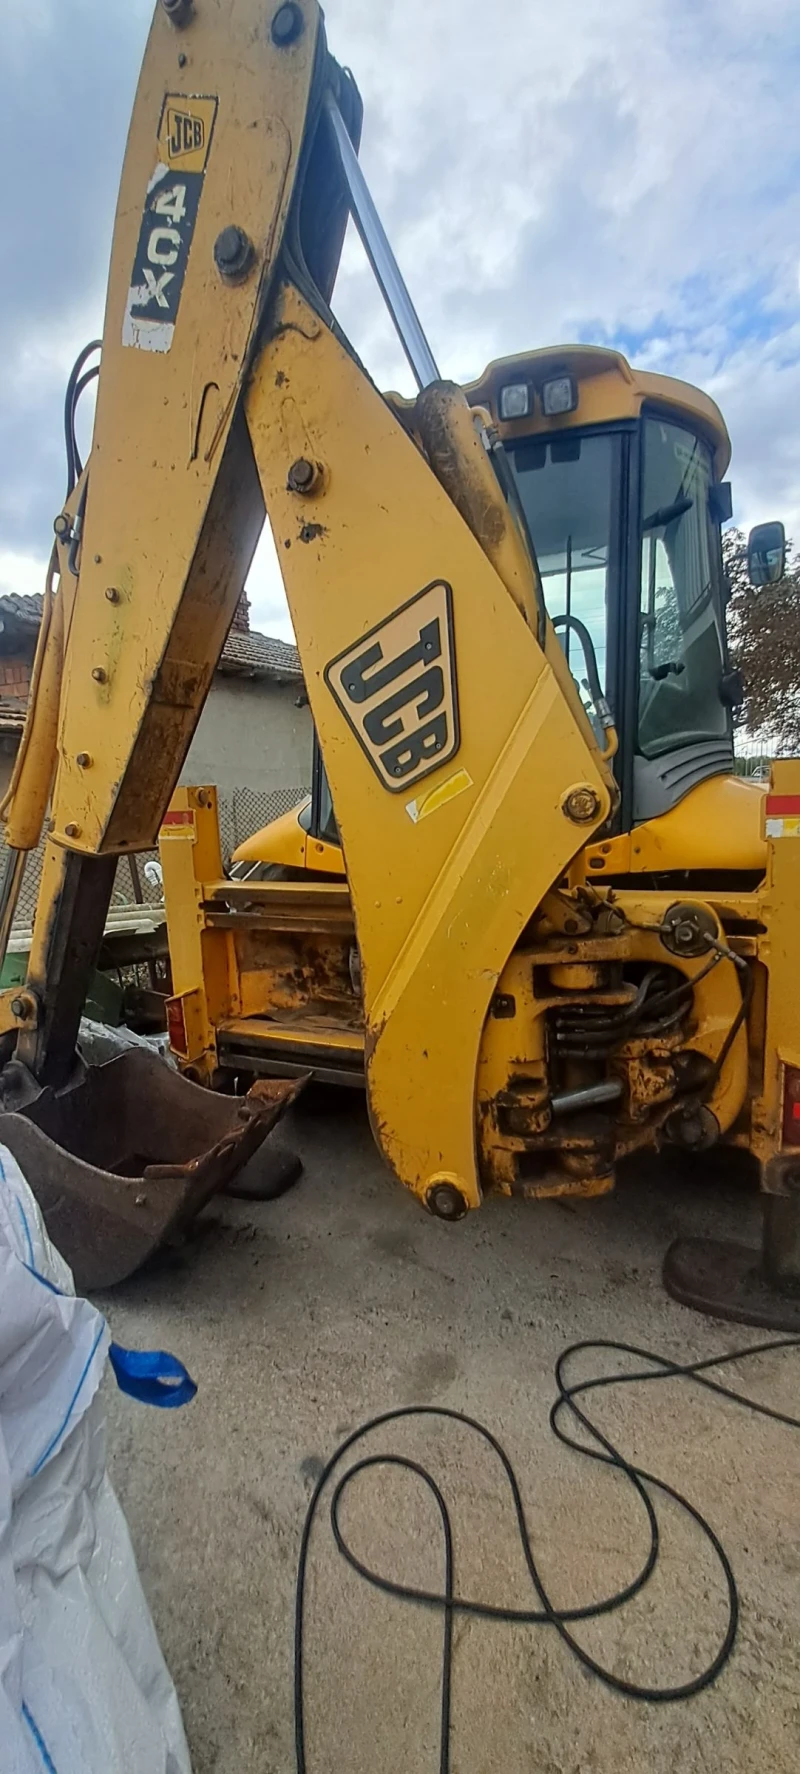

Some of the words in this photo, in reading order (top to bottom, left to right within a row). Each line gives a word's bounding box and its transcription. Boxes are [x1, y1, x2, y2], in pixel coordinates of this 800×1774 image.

[171, 114, 202, 154] JCB
[142, 184, 187, 308] 4CX
[340, 617, 447, 778] JCB
